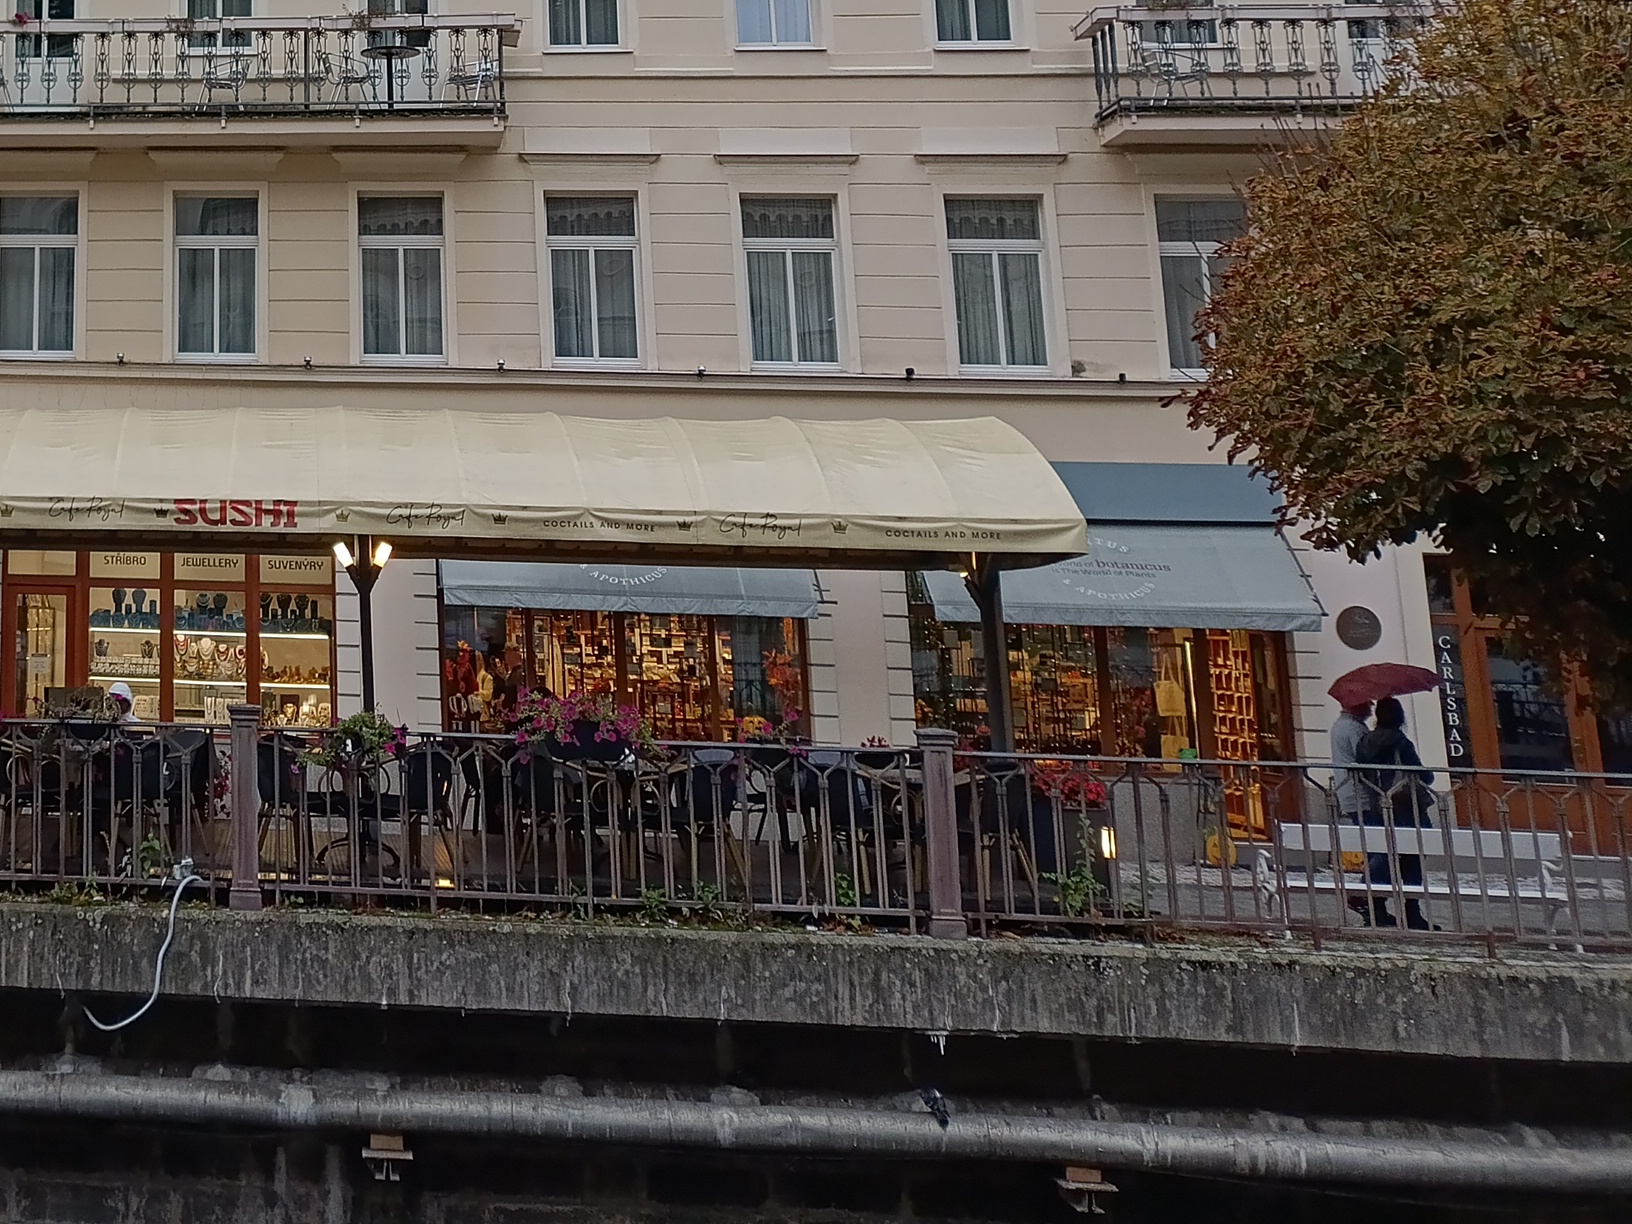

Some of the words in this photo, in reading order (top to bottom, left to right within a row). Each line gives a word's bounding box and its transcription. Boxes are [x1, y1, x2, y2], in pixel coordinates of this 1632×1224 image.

[86, 495, 126, 522] Royal
[173, 498, 299, 529] SUSHI
[424, 501, 466, 530] Royal
[543, 520, 595, 529] COCTAILS
[599, 521, 621, 530] AND
[626, 522, 655, 532] MORE
[759, 511, 802, 540] Royal
[885, 529, 939, 538] COCTAILS
[944, 530, 967, 539] AND
[971, 531, 1002, 540] MORE
[103, 552, 147, 566] STŘÍBRO
[180, 556, 239, 569] JEWELLERY
[267, 557, 324, 571] SUVENÝRY
[1094, 559, 1172, 572] botanicus
[589, 566, 668, 586] APOTHICUS
[1079, 568, 1112, 576] World
[1438, 635, 1465, 757] CARLSBAD
